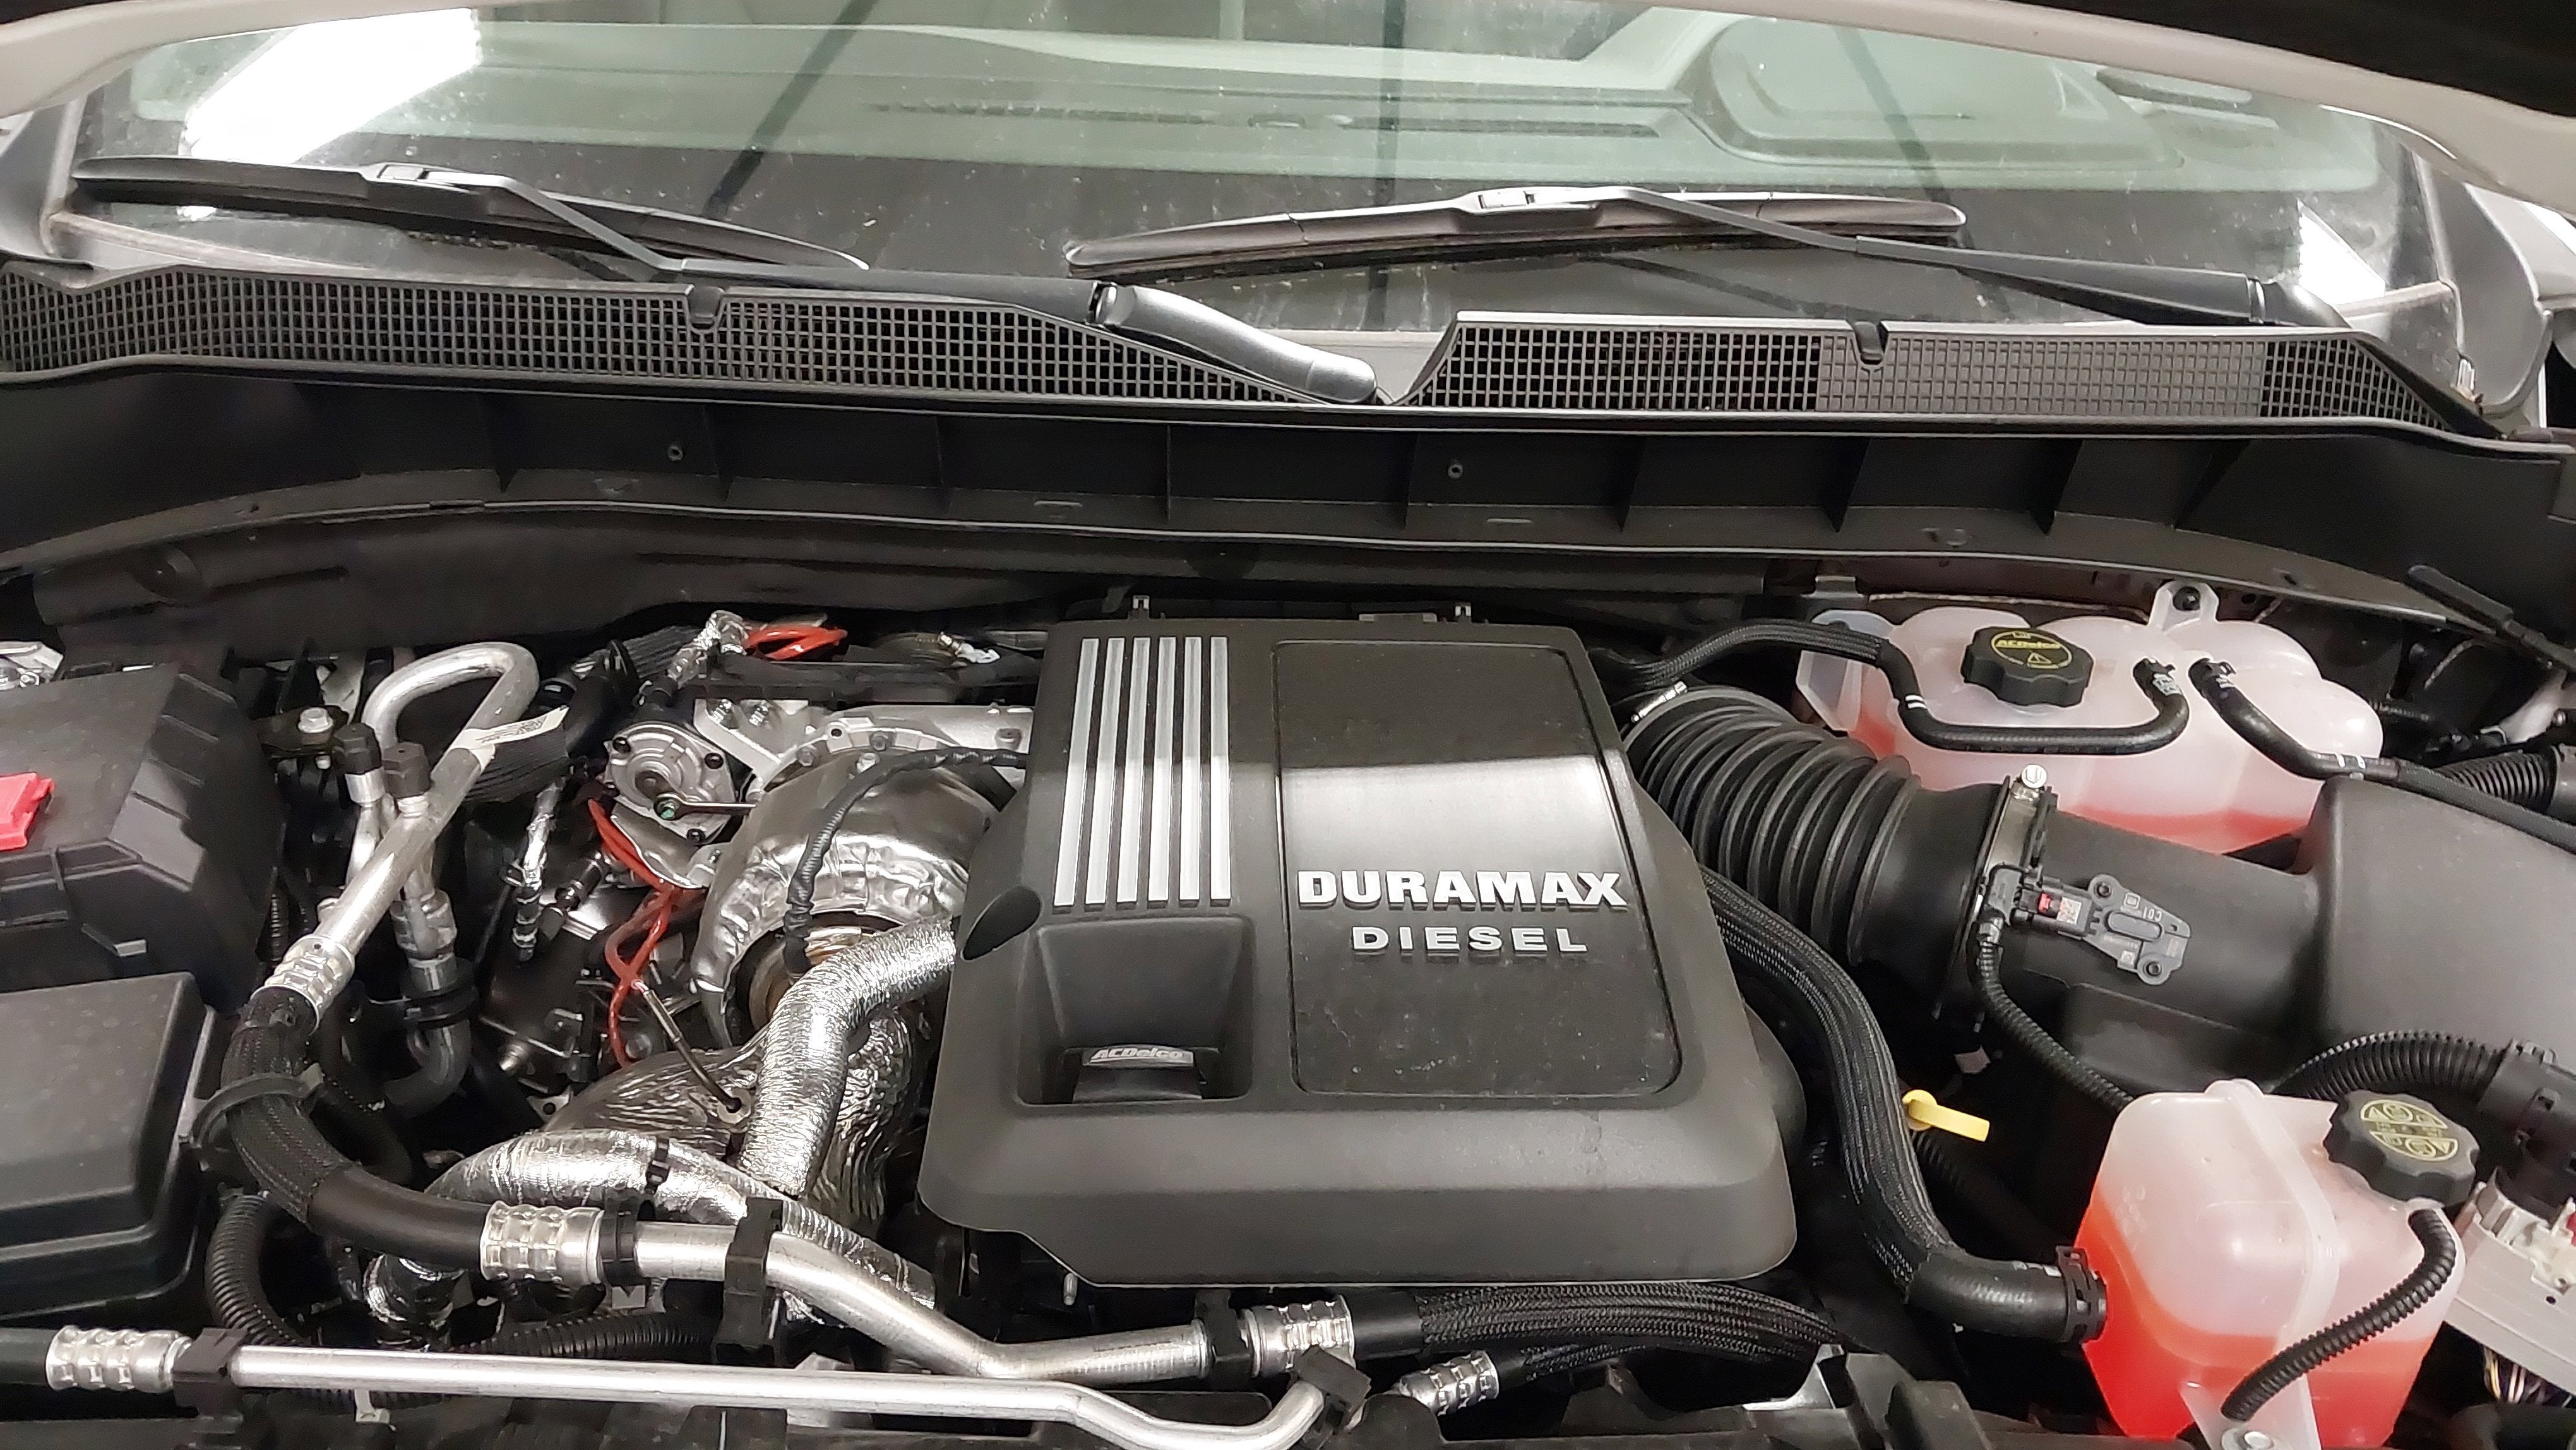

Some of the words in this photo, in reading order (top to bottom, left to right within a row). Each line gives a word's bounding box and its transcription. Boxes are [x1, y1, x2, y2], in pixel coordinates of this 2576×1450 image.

[1297, 870, 1628, 909] DURAMAX
[1351, 926, 1588, 954] DIESEL
[1090, 1046, 1184, 1060] ACDelco
